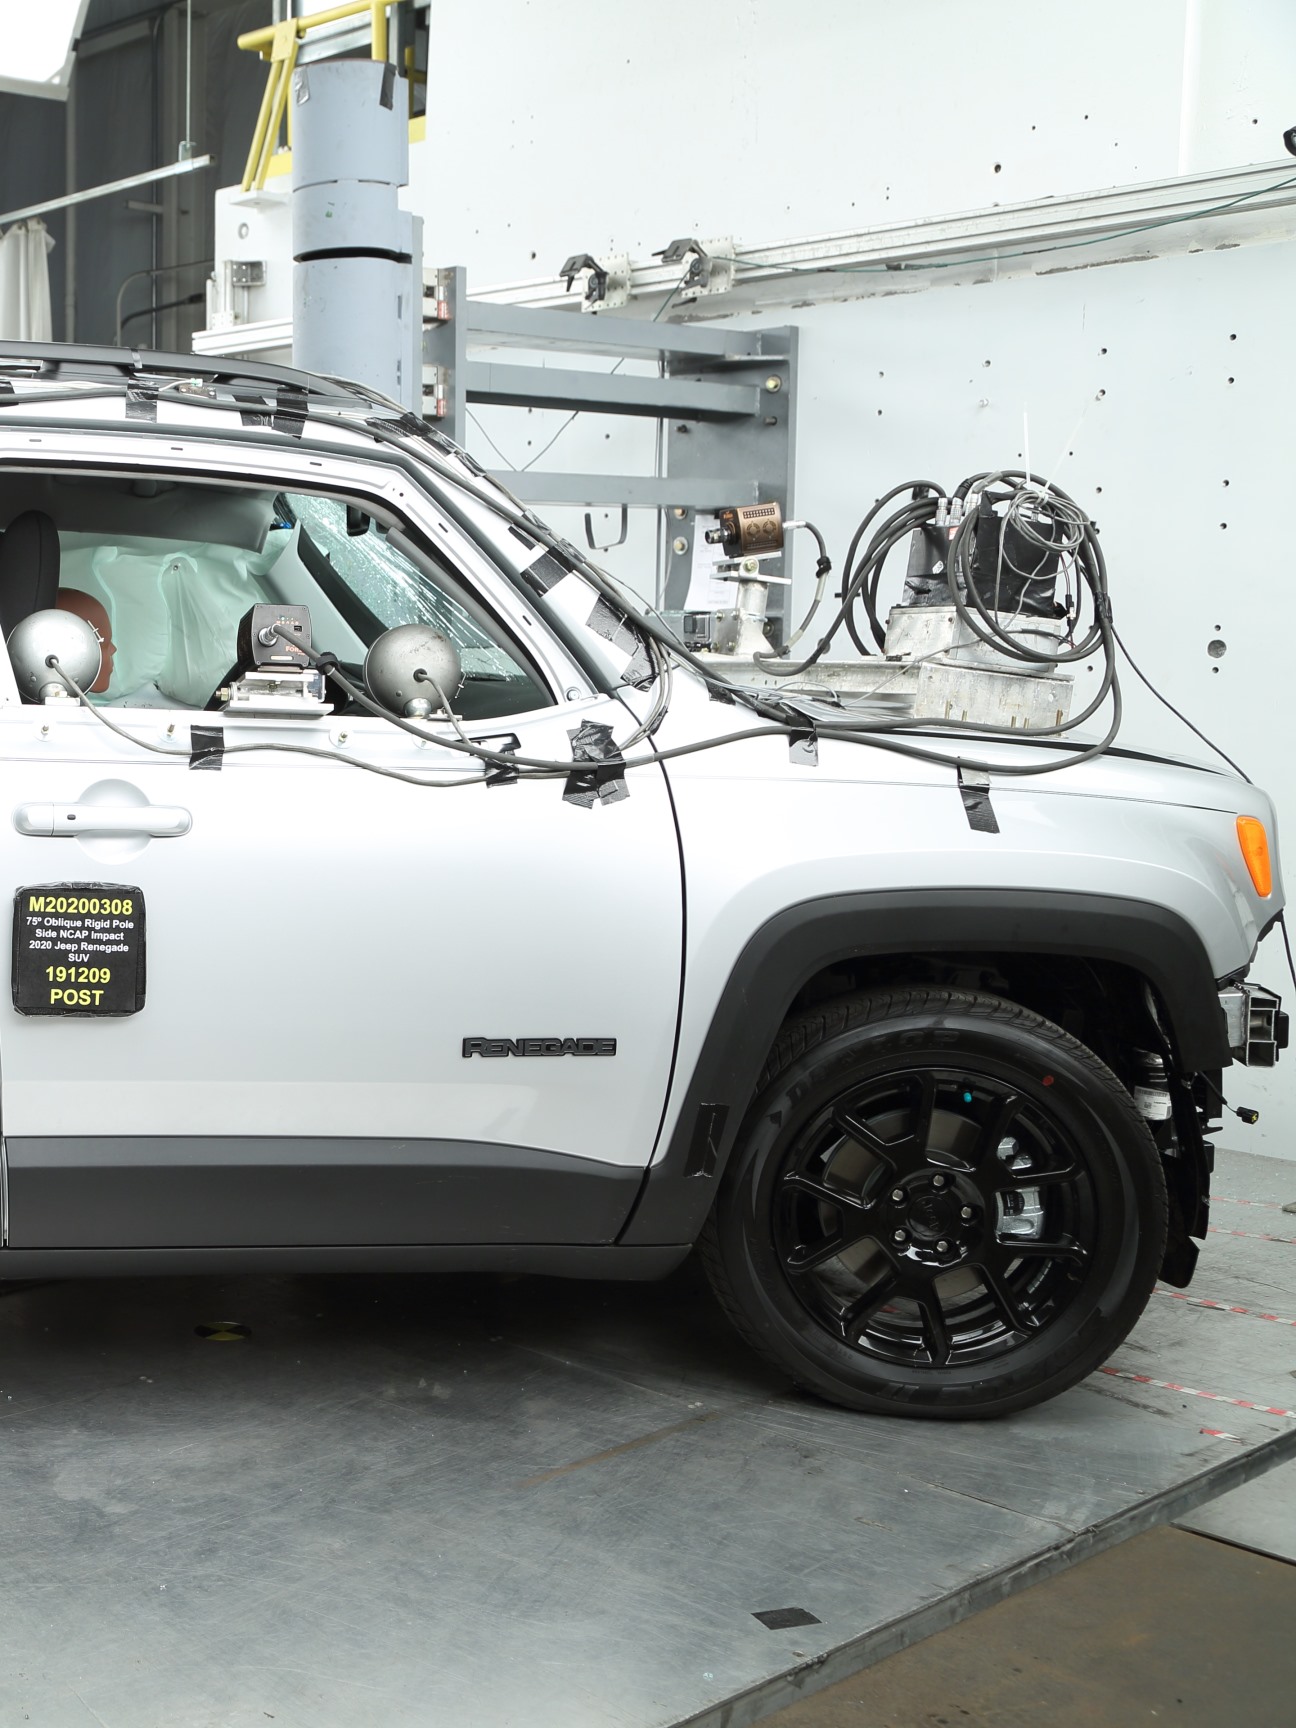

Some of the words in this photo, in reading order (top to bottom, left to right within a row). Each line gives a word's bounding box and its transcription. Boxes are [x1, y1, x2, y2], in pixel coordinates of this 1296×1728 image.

[30, 897, 132, 915] M20200308
[44, 917, 82, 928] Oblique
[85, 919, 110, 930] Rigid
[113, 920, 134, 928] Pole
[36, 929, 57, 937] Side
[60, 930, 88, 938] NCAP
[91, 931, 124, 941] Impact
[29, 940, 52, 949] 2020
[55, 941, 78, 952] Jeep
[81, 942, 129, 953] Renegade
[68, 953, 89, 962] SUV
[46, 966, 110, 983] 191209
[51, 989, 104, 1005] POST
[462, 1037, 617, 1058] RENEGADE
